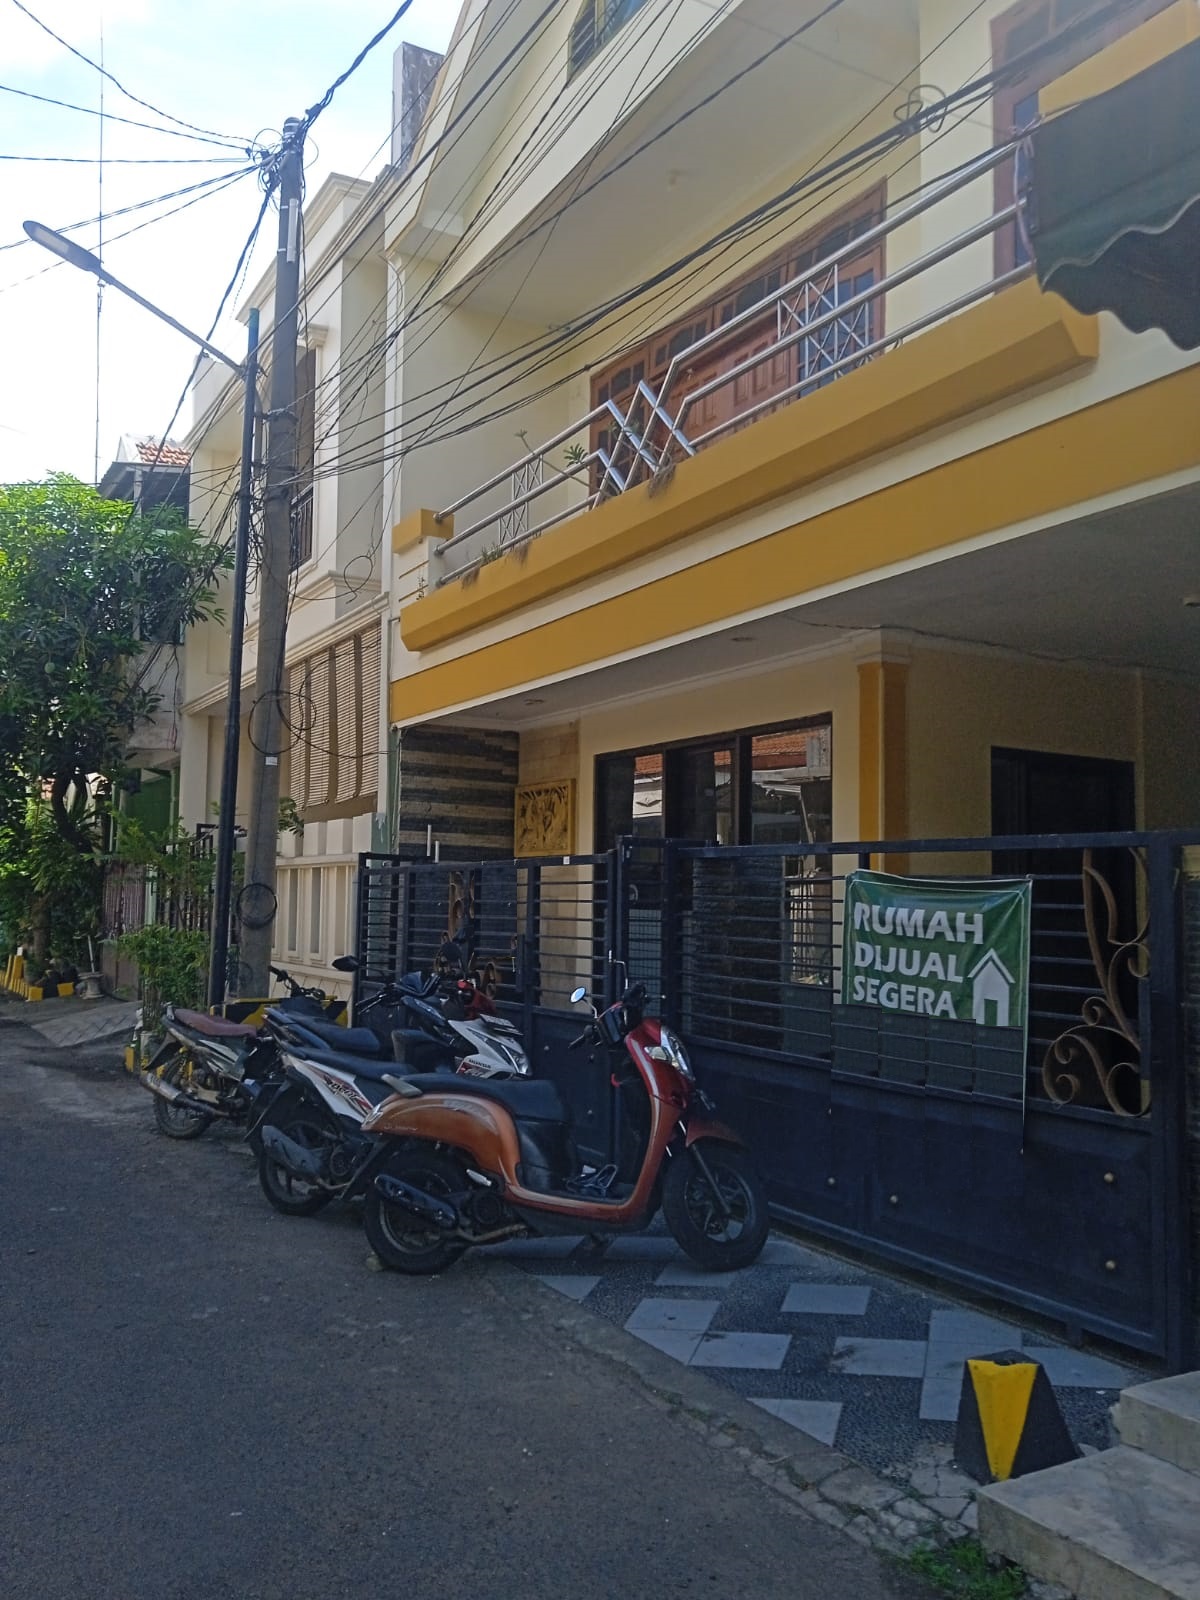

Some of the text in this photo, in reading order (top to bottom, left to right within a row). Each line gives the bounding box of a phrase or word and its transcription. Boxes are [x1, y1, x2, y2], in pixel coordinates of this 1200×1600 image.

[854, 902, 984, 945] RUMAH
[854, 941, 963, 983] DIJUAL
[853, 975, 958, 1019] SEGERA
